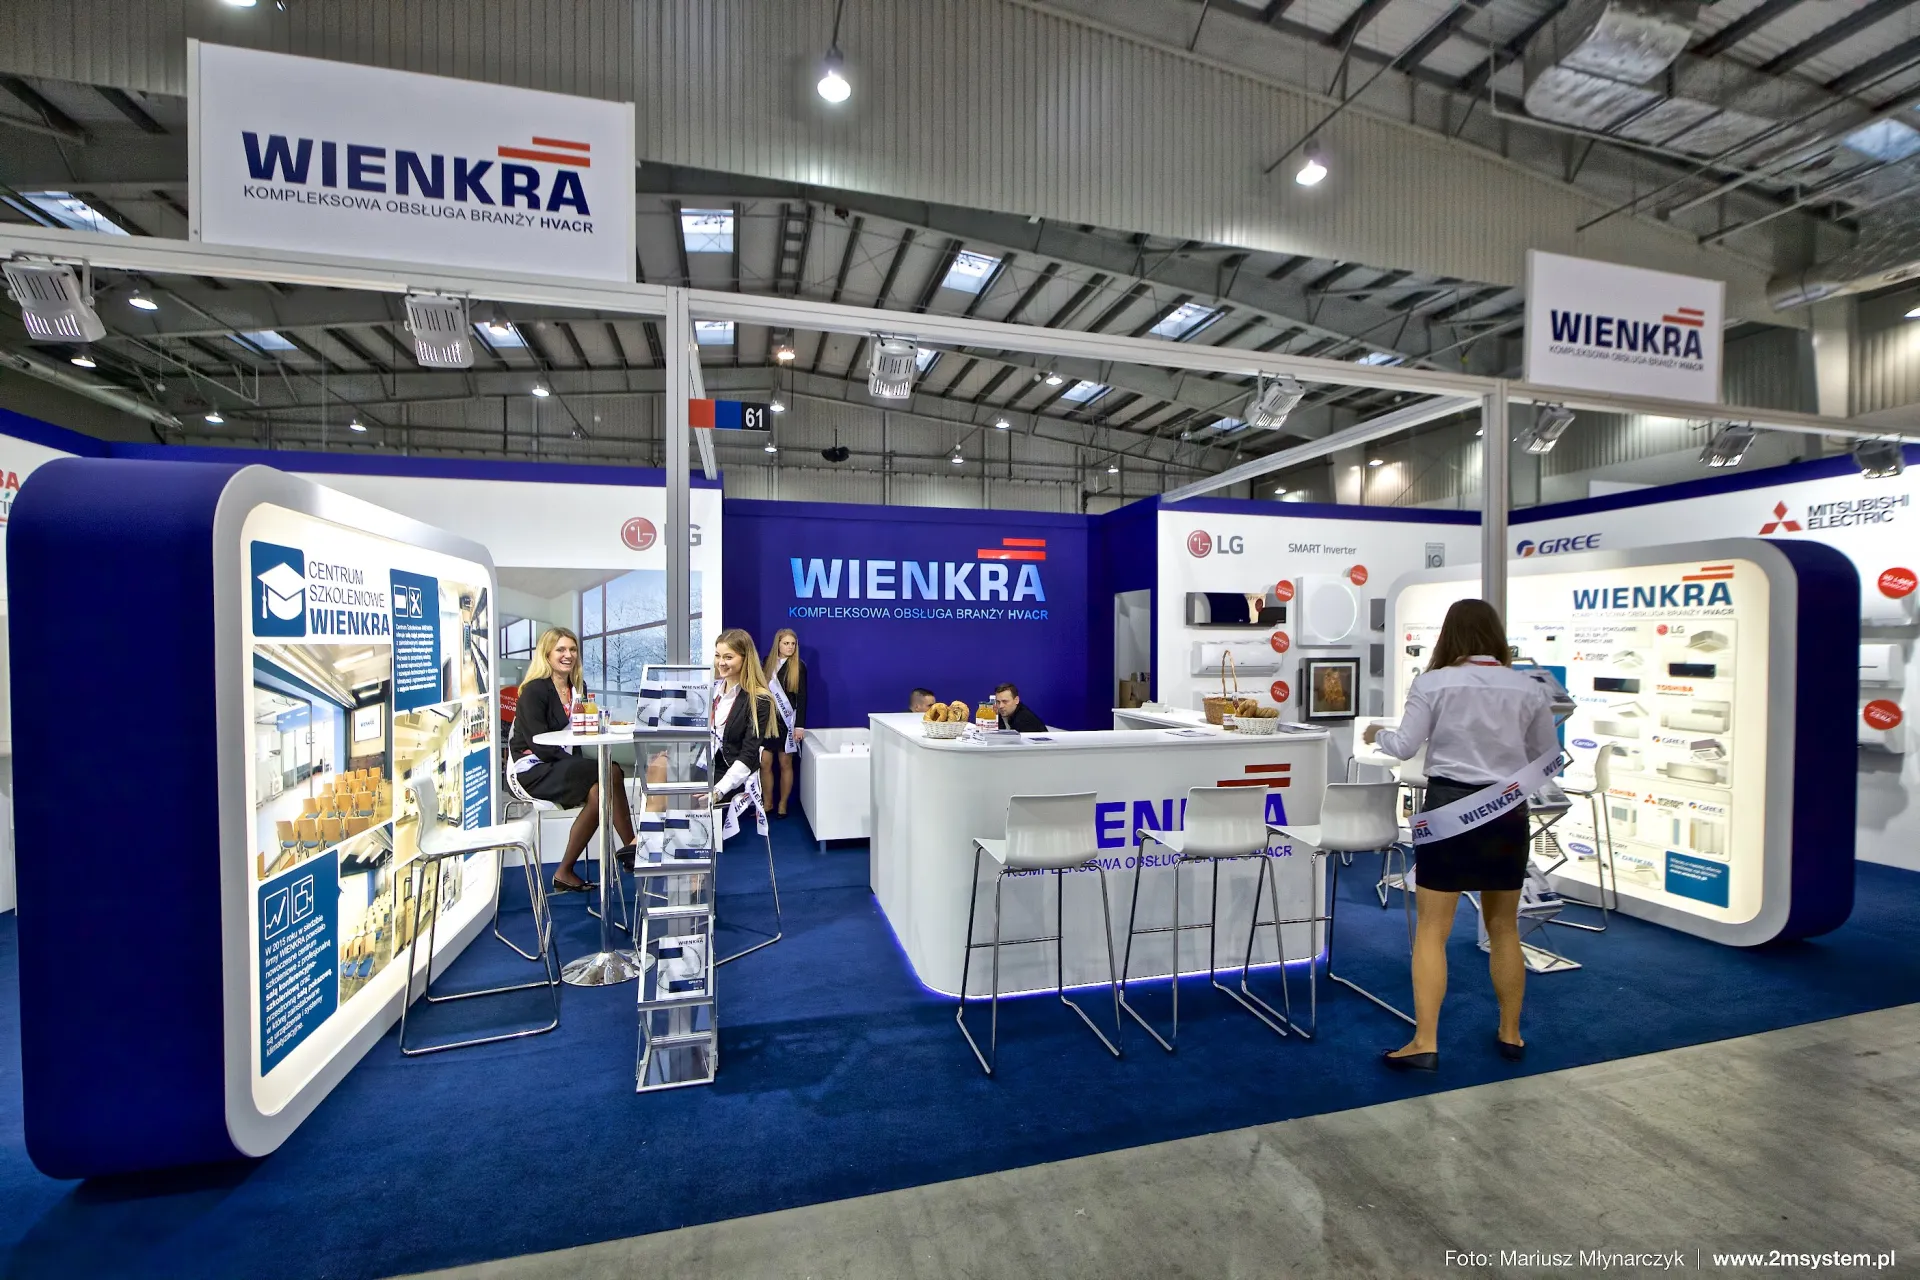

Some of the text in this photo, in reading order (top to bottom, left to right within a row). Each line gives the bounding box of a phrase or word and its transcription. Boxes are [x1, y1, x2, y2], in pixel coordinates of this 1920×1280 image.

[242, 131, 591, 216] WIENKRA
[243, 185, 594, 234] KOMPLEKSOWA OBSŁUGA BRANŻY HVACR
[1551, 309, 1703, 359] WIENKRA
[745, 408, 763, 428] 61
[1808, 494, 1909, 517] MITSUBISHI
[1807, 509, 1894, 530] ELECTRIC
[1217, 535, 1243, 554] LG
[1288, 543, 1357, 555] SMART Inverter
[1538, 533, 1602, 554] GREE
[308, 560, 364, 585] CENTRUM
[790, 557, 1046, 602] WIENKRA
[309, 584, 385, 608] SZKOLENIOWE
[1573, 582, 1733, 610] WIENKRA
[310, 608, 390, 635] WIENKRA
[788, 605, 1049, 620] KOMPLEKSOWA OBSŁUGA BRANŻY HVACR
[1459, 788, 1524, 825] WIENKRA
[279, 935, 306, 958] WIENKRA
